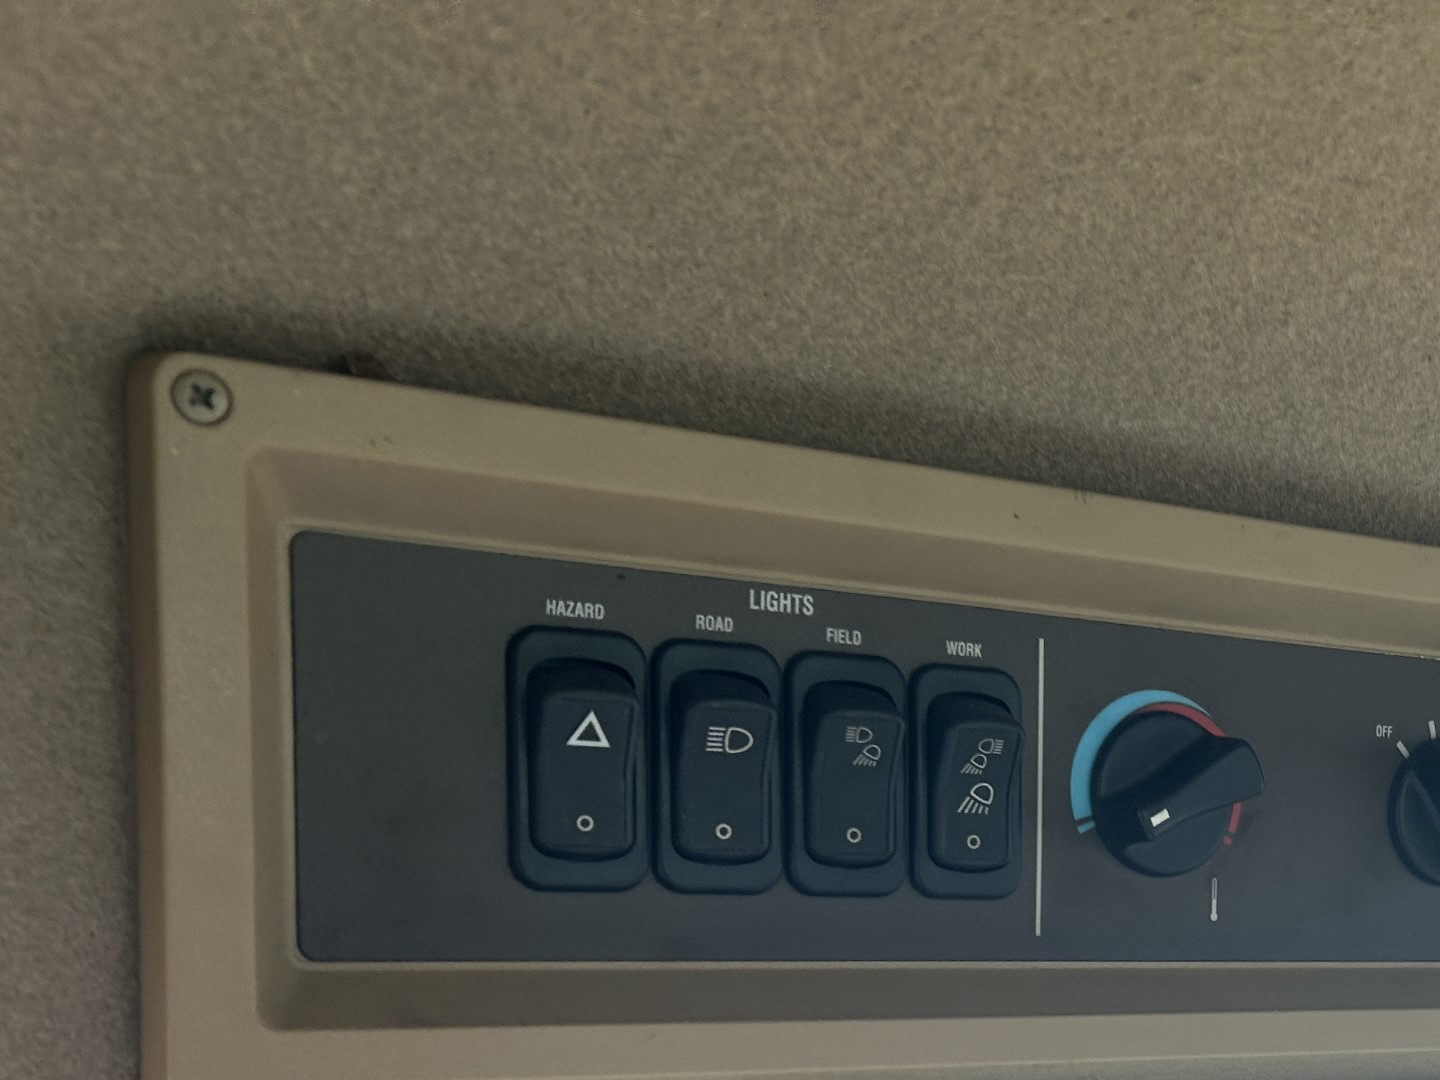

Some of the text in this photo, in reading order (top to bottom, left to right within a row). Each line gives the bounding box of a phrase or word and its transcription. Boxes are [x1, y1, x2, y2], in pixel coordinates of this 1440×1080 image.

[546, 599, 605, 620] HAZARD
[749, 589, 815, 616] LIGHTS
[696, 614, 734, 633] ROAD
[826, 627, 862, 646] FIELD
[946, 640, 983, 659] WORK
[1376, 724, 1393, 738] OFF
